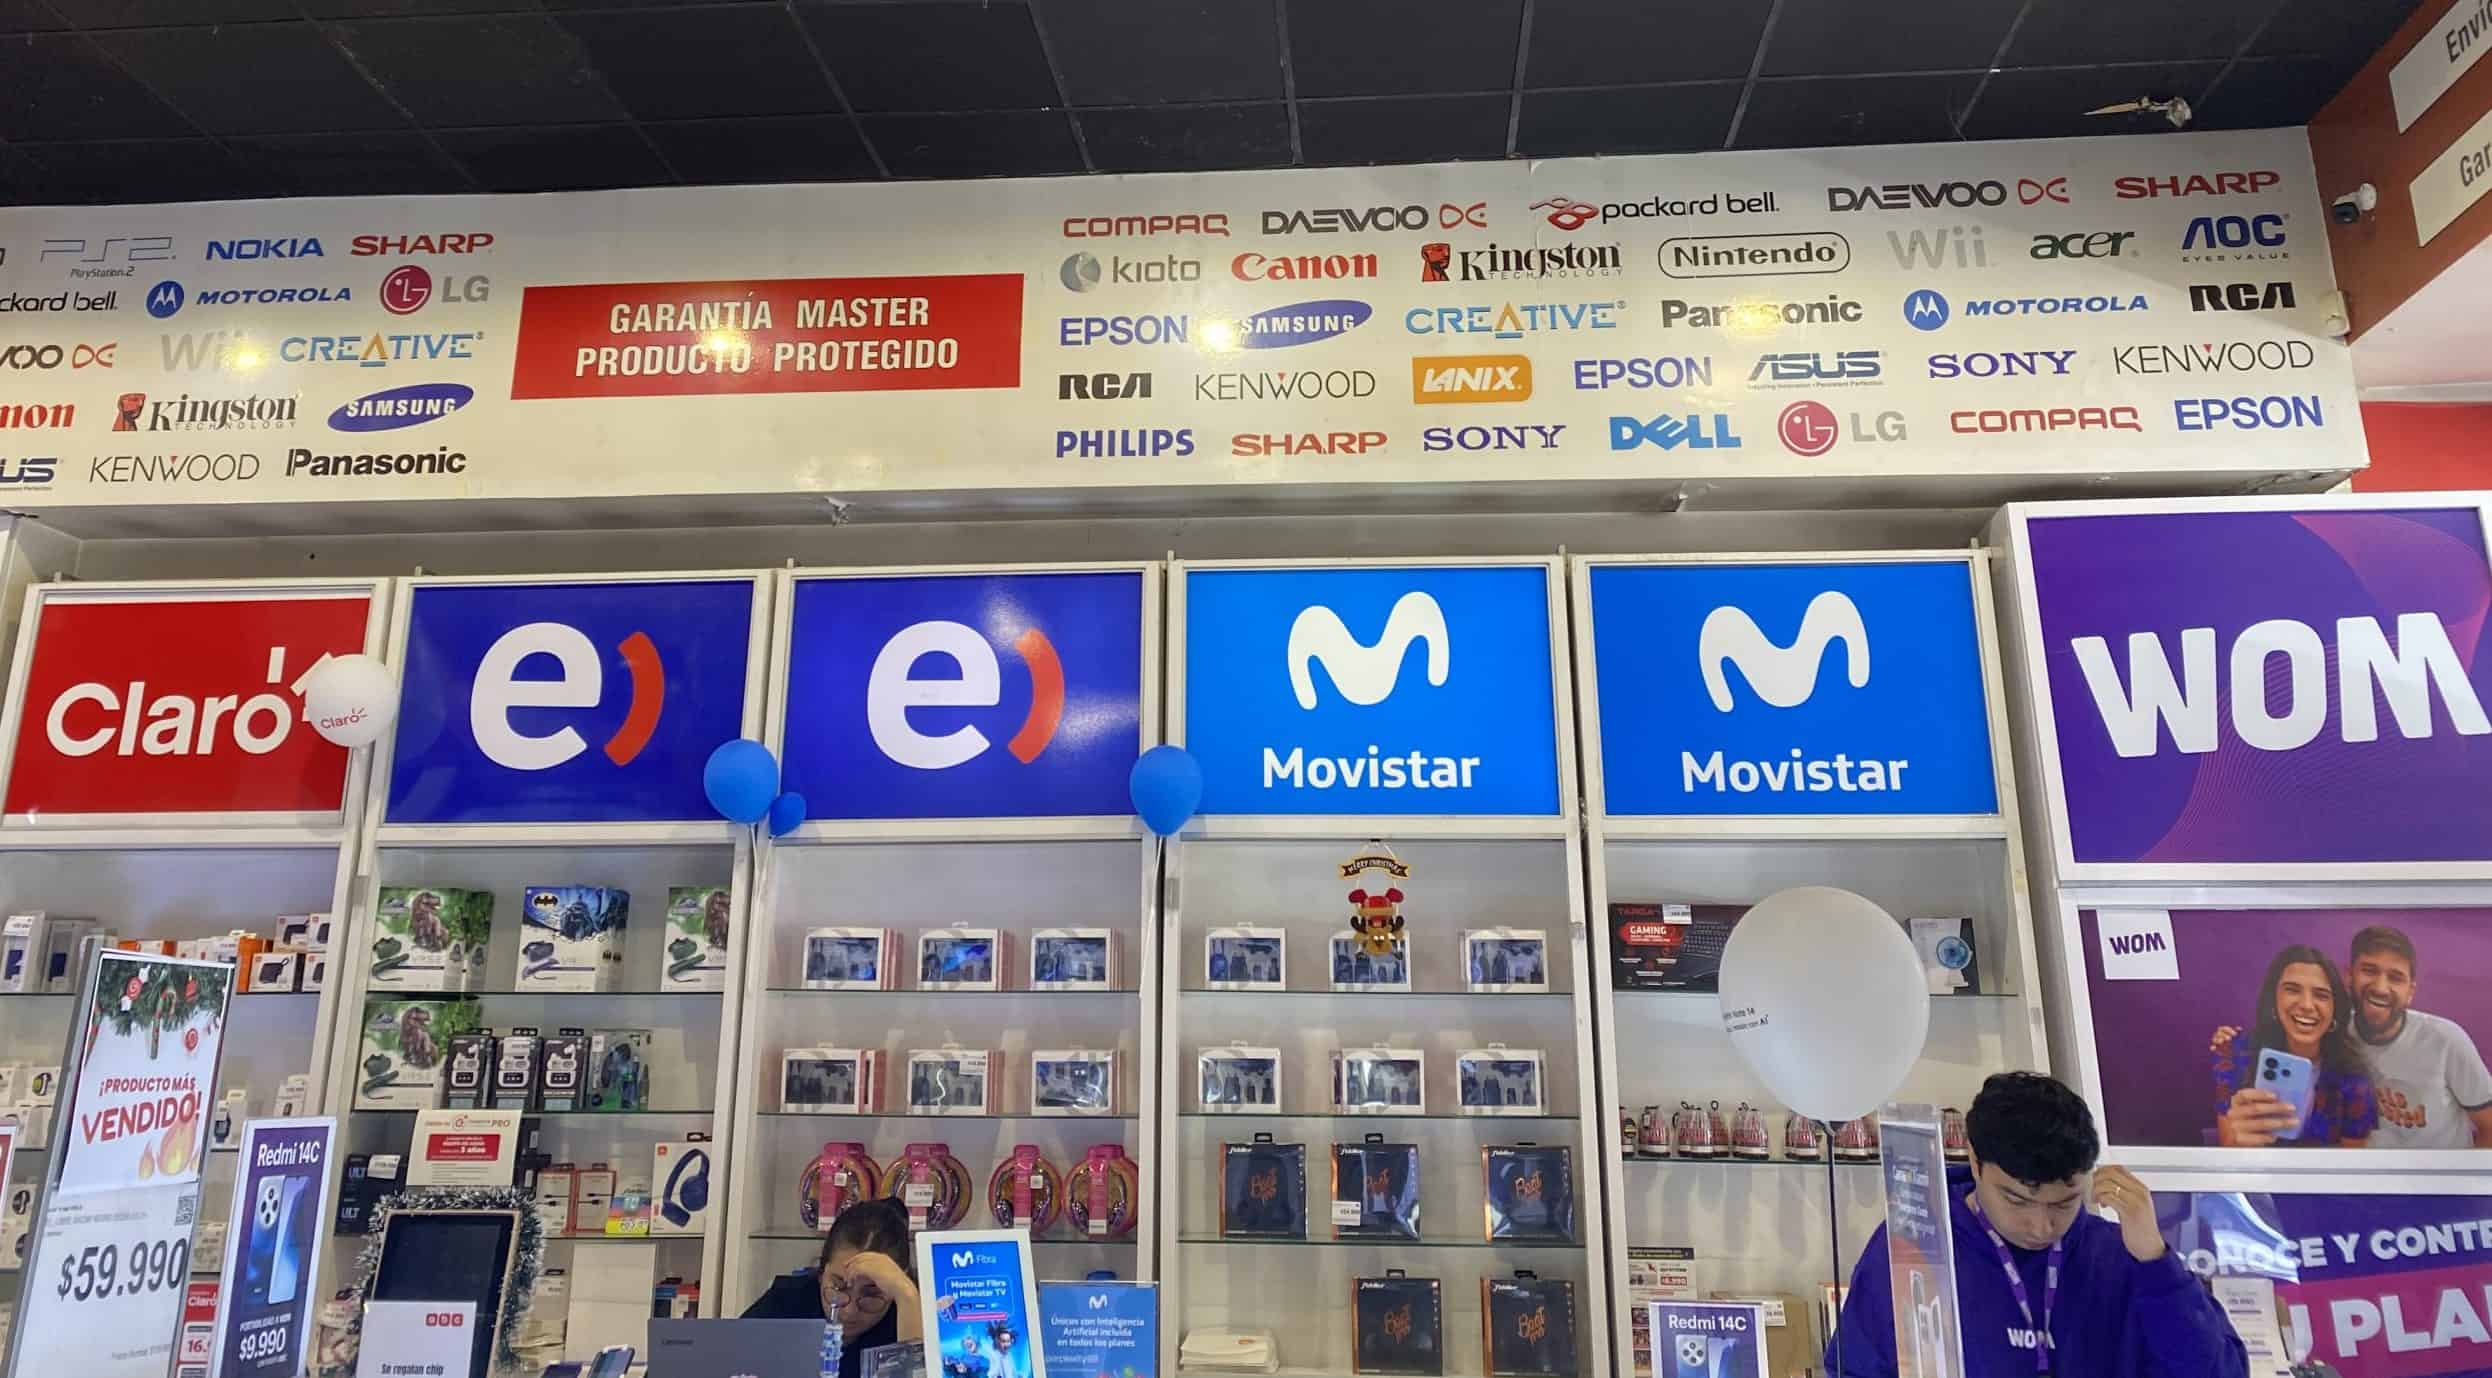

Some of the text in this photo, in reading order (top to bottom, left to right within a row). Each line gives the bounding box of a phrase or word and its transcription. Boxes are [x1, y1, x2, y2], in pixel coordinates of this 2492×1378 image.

[1828, 179, 2007, 212] DAEWOO
[2115, 171, 2281, 199] SHARP
[1261, 205, 1429, 235] DAEWOO
[1602, 194, 1719, 225] packard
[1063, 213, 1231, 238] COMPAQ
[2182, 213, 2286, 250] AOC
[205, 237, 325, 262] NOKIA
[350, 232, 494, 257] SHARP
[1673, 240, 1837, 268] Nintendo
[1887, 224, 1987, 271] Wii
[2029, 230, 2136, 260] acer
[1112, 254, 1201, 284] kioto
[1231, 252, 1379, 282] Canon
[1459, 241, 1622, 281] Kingston
[1488, 266, 1624, 280] TECHNOLOGY
[195, 286, 352, 306] MOTOROLA
[441, 274, 491, 304] LG
[2189, 281, 2297, 313] RCA
[609, 291, 930, 335] GARANTÍA MASTER
[1405, 301, 1618, 339] CREATIVE
[1964, 295, 2150, 316] MOTOROLA
[1060, 314, 1188, 346] EPSON
[1239, 314, 1355, 337] SAMSUNG
[280, 331, 475, 367] CREATIVE
[575, 337, 959, 378] PRODUCTO PROTEGIDO
[2112, 340, 2315, 376] KENWOOD
[1574, 356, 1713, 390] EPSON
[1747, 350, 1881, 380] ASUS
[1928, 350, 2077, 380] SONY
[1058, 372, 1153, 400] RCA
[1195, 370, 1376, 401] KENWOOD
[148, 393, 298, 432] Kingston
[346, 396, 457, 417] SAMSUNG
[1950, 406, 2144, 434] COMPAQ
[2172, 395, 2325, 432] EPSON
[1423, 424, 1567, 452] SONY
[1608, 413, 1742, 452] DELL
[1850, 410, 1908, 443] LG
[1056, 428, 1195, 458] PHILIPS
[1231, 431, 1388, 457] SHARP
[89, 453, 260, 483] KENWOOD
[286, 446, 467, 478] Panasonic
[2071, 611, 2492, 758] WOM
[45, 678, 291, 758] Claro
[320, 712, 361, 730] Claro
[1262, 746, 1481, 791] Movistar
[1681, 750, 1909, 793] Movistar
[1629, 925, 1667, 935] GAMING
[2108, 930, 2167, 956] WOM
[98, 1072, 197, 1097] ¡PRODUCTO MÁS
[81, 1090, 203, 1145] VENDIDO!
[256, 1140, 321, 1168] Redmi 14C
[2333, 1233, 2360, 1264] Y
[56, 1237, 188, 1302] $59.990
[1667, 1313, 1747, 1331] Redmi 14C
[239, 1327, 287, 1361] $9.990
[381, 1362, 391, 1375] Se
[425, 1362, 445, 1377] chip
